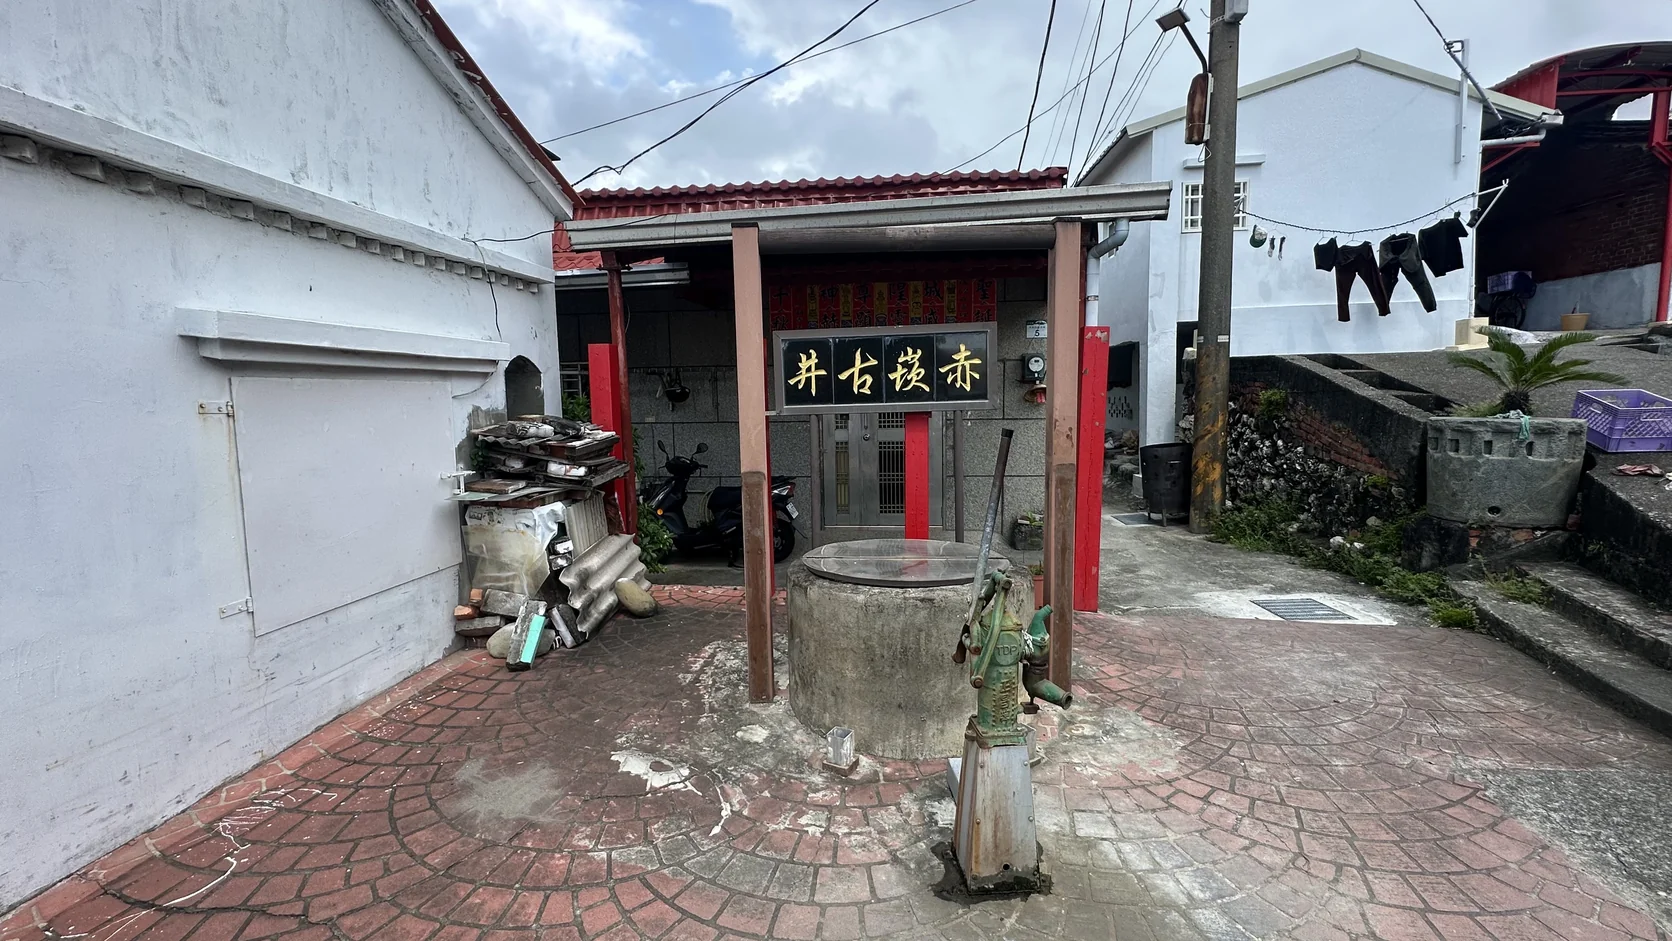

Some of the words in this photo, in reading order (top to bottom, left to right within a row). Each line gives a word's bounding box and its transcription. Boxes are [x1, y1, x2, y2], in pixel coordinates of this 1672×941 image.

[1034, 329, 1040, 337] 5
[787, 344, 982, 397] 赤崁古井
